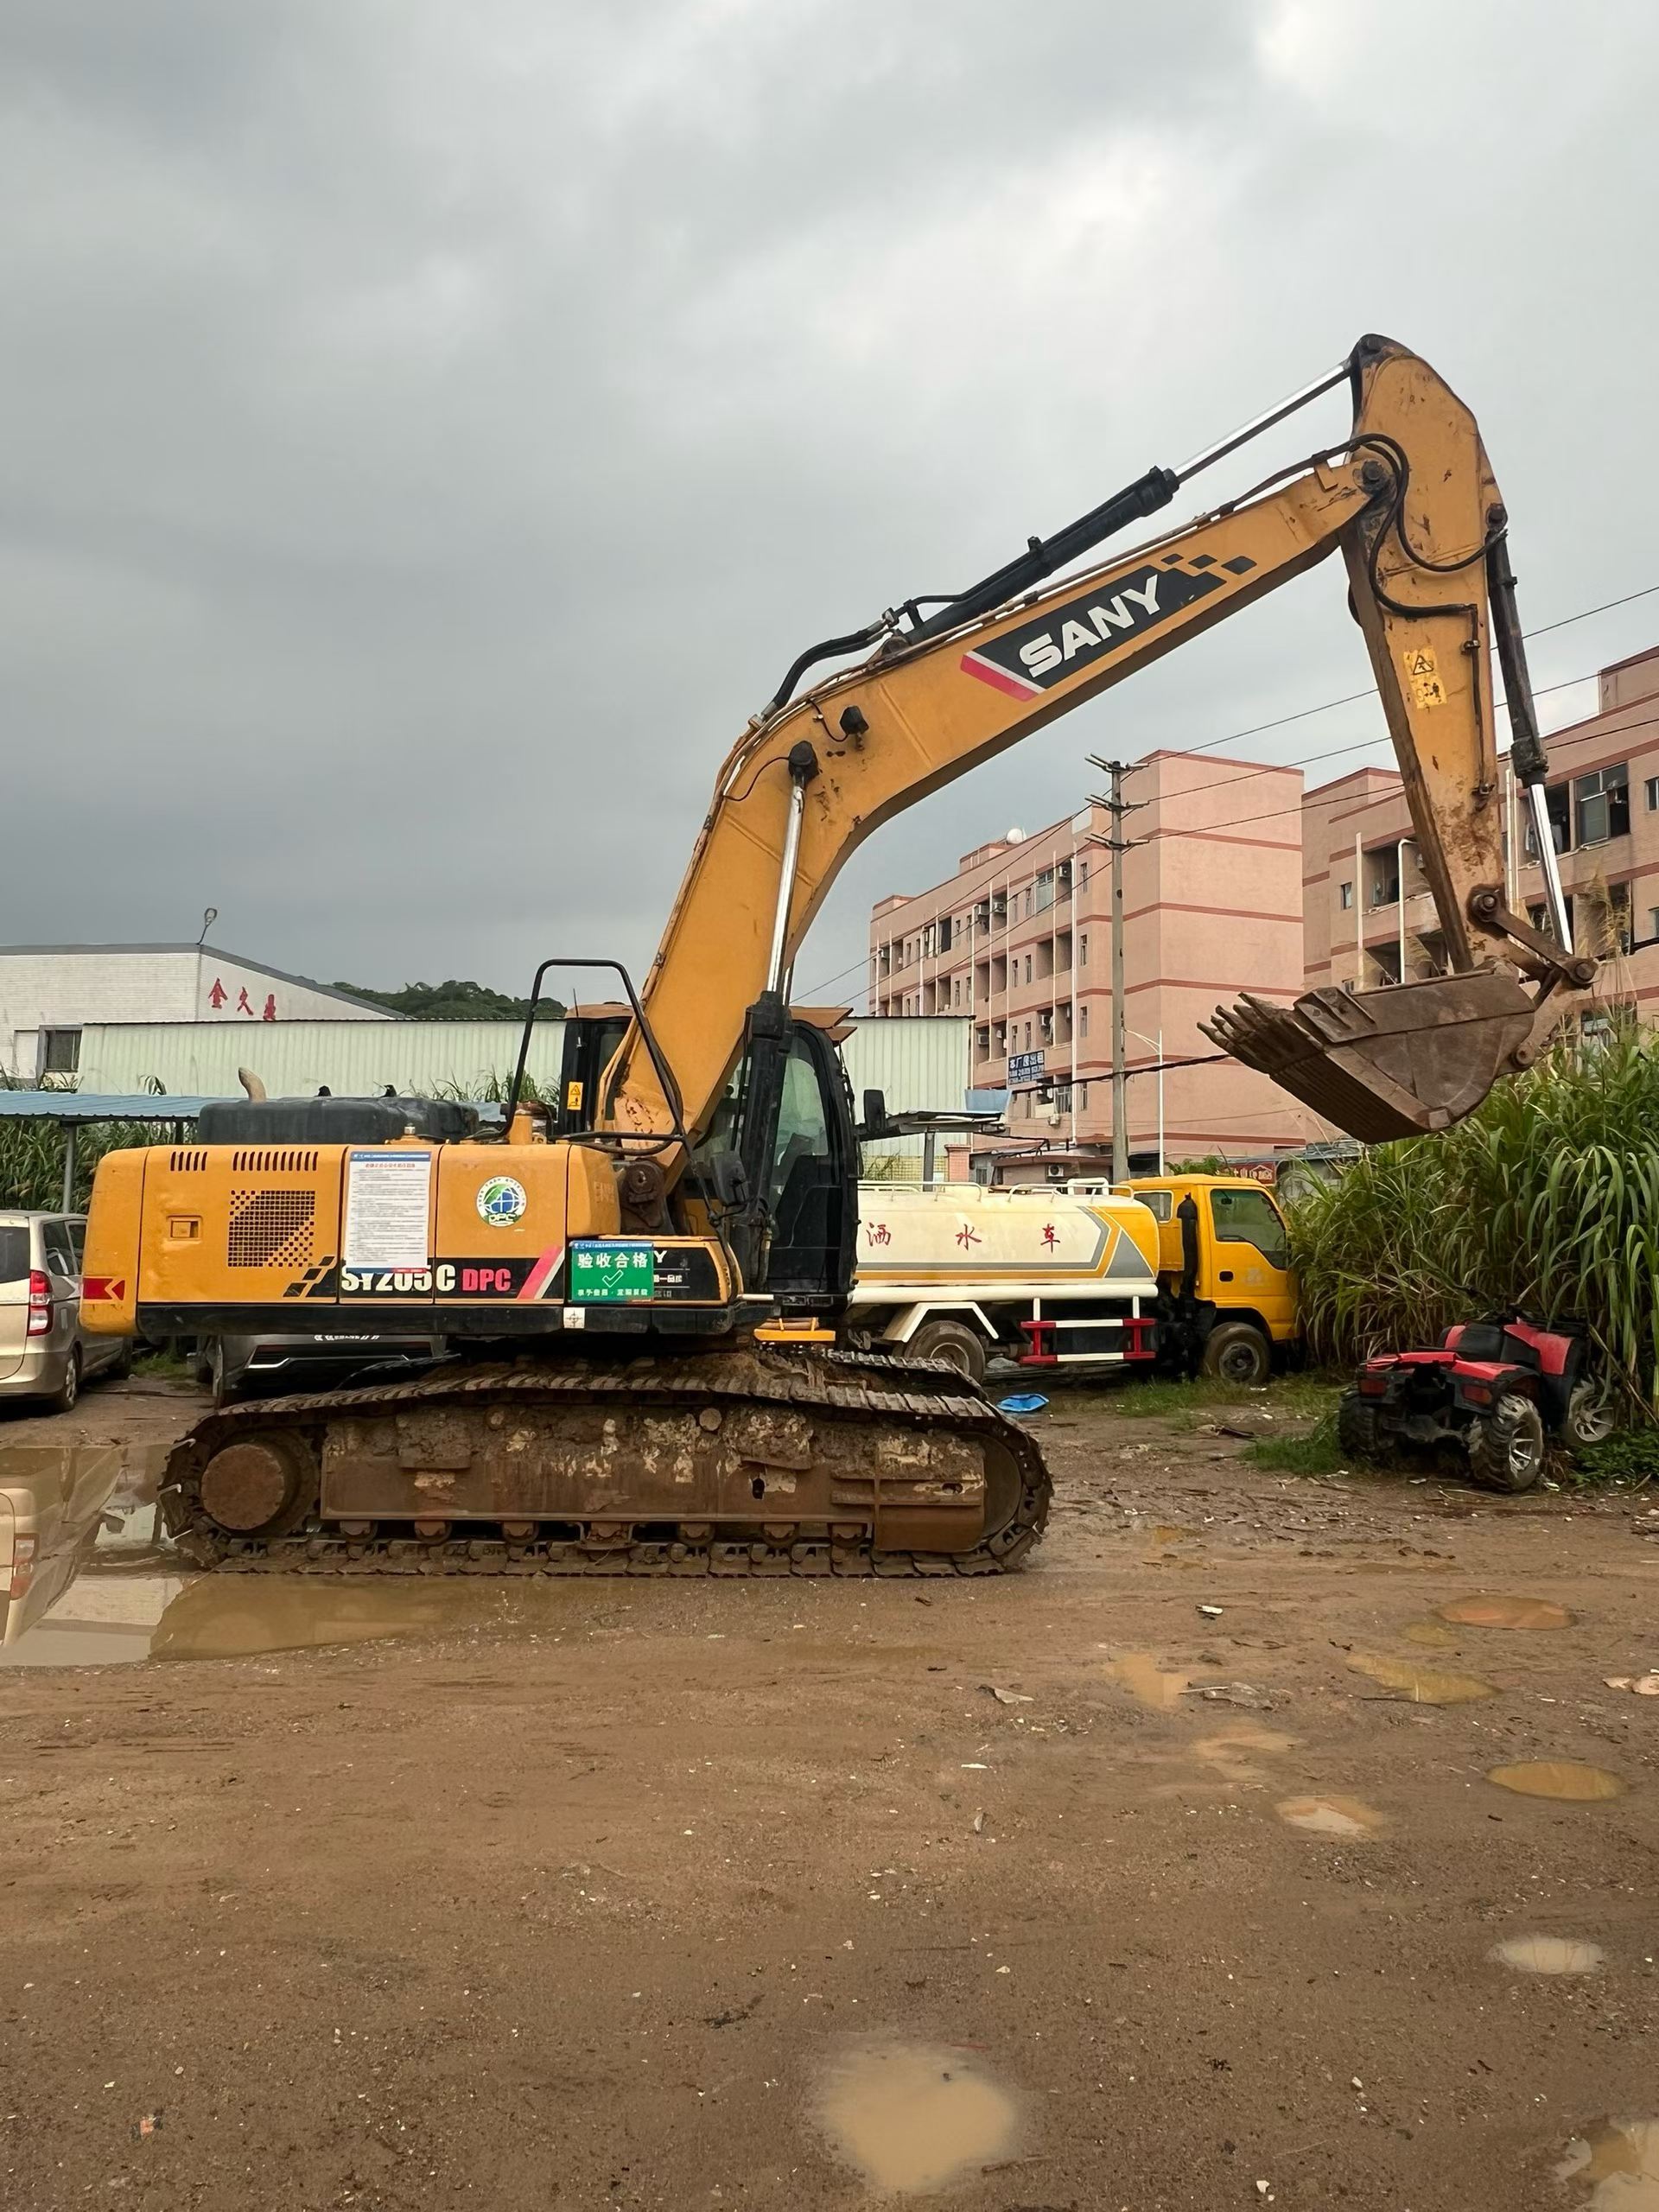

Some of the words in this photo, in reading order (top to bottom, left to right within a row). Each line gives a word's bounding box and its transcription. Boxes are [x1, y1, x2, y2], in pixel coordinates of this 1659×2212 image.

[1020, 574, 1161, 677] SANY
[866, 1222, 1060, 1253] 洒水车
[577, 1252, 648, 1269] 验收合格
[462, 1268, 511, 1292] DPC
